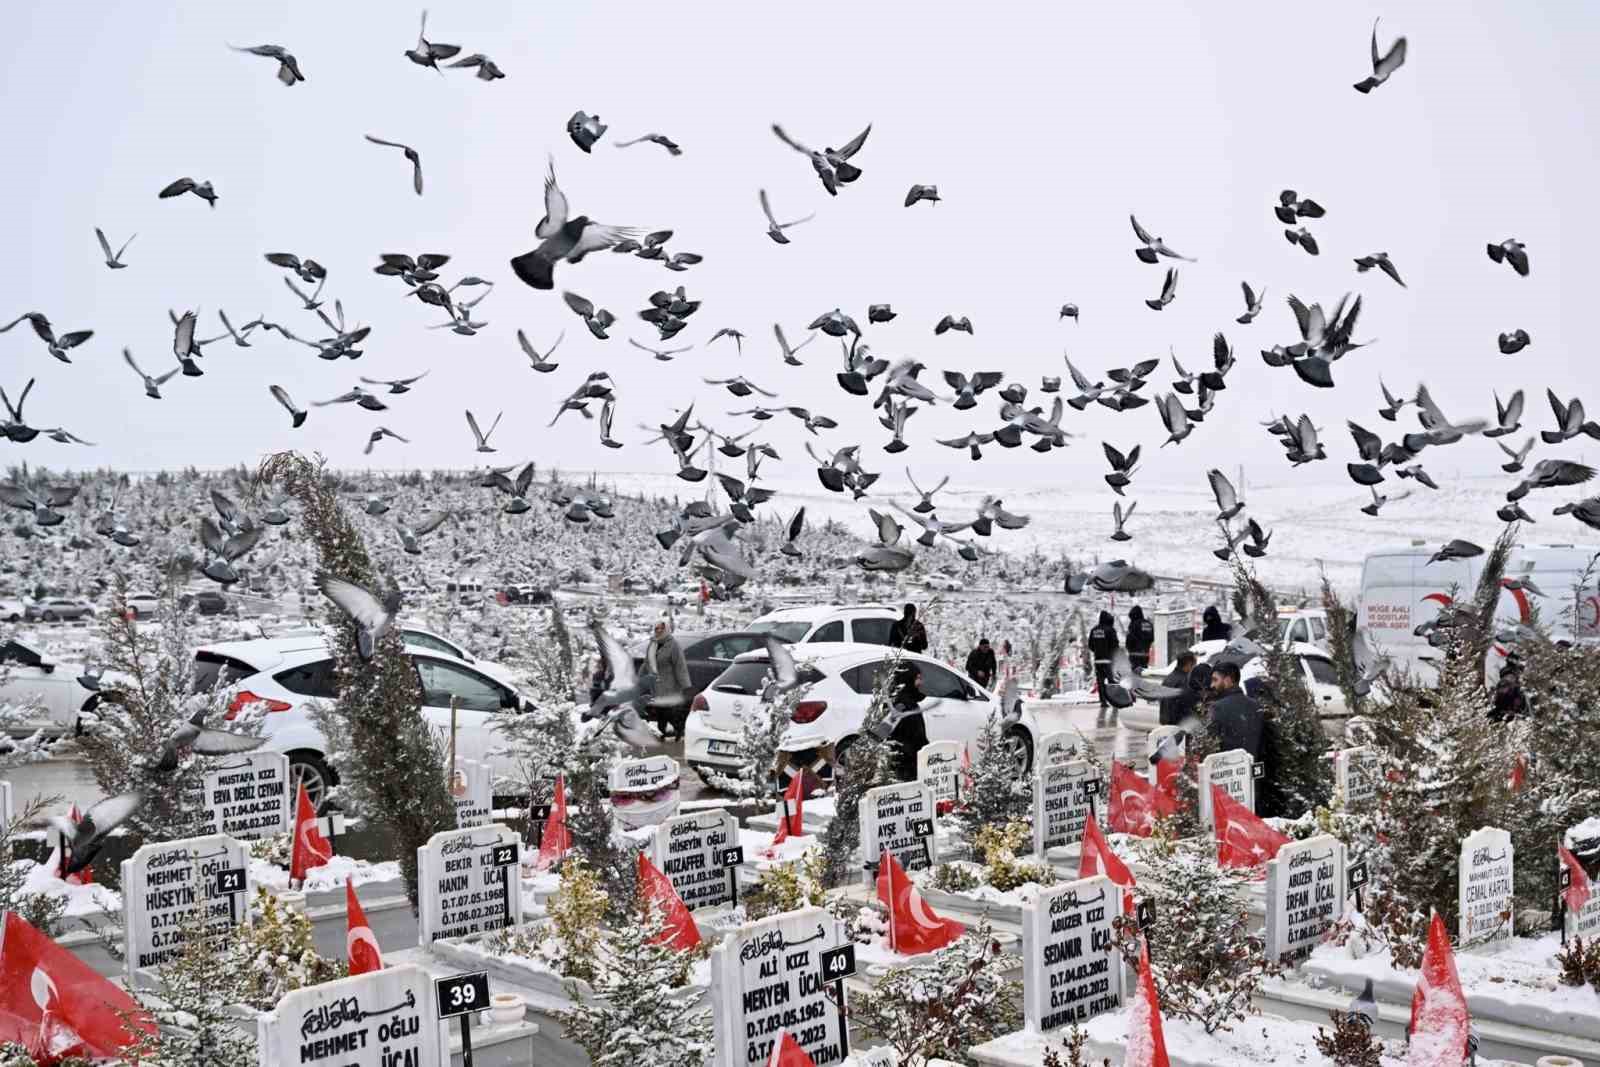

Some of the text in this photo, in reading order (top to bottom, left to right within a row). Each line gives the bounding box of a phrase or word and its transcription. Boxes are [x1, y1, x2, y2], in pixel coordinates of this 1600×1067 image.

[218, 772, 255, 786] MUSTAFA
[258, 769, 276, 780] KIZI
[628, 778, 648, 787] CEMAL
[214, 789, 231, 804] ERVA
[234, 784, 255, 801] DENİZ
[258, 782, 284, 798] CEYHAN
[1046, 796, 1068, 812] ENSAR
[223, 800, 280, 818] D.T.04.04.2022
[460, 808, 488, 820] ÇOBAN
[878, 802, 922, 819] BAYRAM KIZI
[878, 822, 896, 838] AYŞE
[918, 824, 928, 834] 24
[668, 831, 726, 854] HÜSEYİN OĞLU
[498, 848, 512, 862] 22
[664, 853, 706, 876] MUZAFFER
[726, 851, 738, 864] 23
[146, 866, 192, 887] MEHMET
[224, 873, 238, 888] 21
[439, 874, 469, 894] HANIM
[1288, 862, 1334, 888] ABUZER OĞLU
[1352, 868, 1364, 882] 42
[1468, 869, 1493, 882] MAHMUT
[146, 883, 194, 911] HÜSEYİN
[442, 888, 504, 910] D.T.07.05.1968
[1286, 882, 1336, 911] İRFAN ÜCAL
[442, 904, 504, 926] Ö.T.06.02.2023
[1051, 906, 1105, 934] ABUZER KIZI
[1044, 936, 1082, 967] SEDANUR
[760, 950, 810, 980] ALİ KIZI
[830, 954, 846, 973] 40
[1050, 958, 1109, 988] D.T.04.03.2002
[450, 983, 476, 1007] 39
[742, 981, 790, 1014] MERYEM
[1051, 978, 1110, 1008] Ö.T.06.02.2023
[746, 1000, 826, 1039] D.T.03.05.1962
[1041, 994, 1120, 1031] RUHUNA EL FATİHA
[300, 1015, 420, 1064] MEHMET OĞLU
